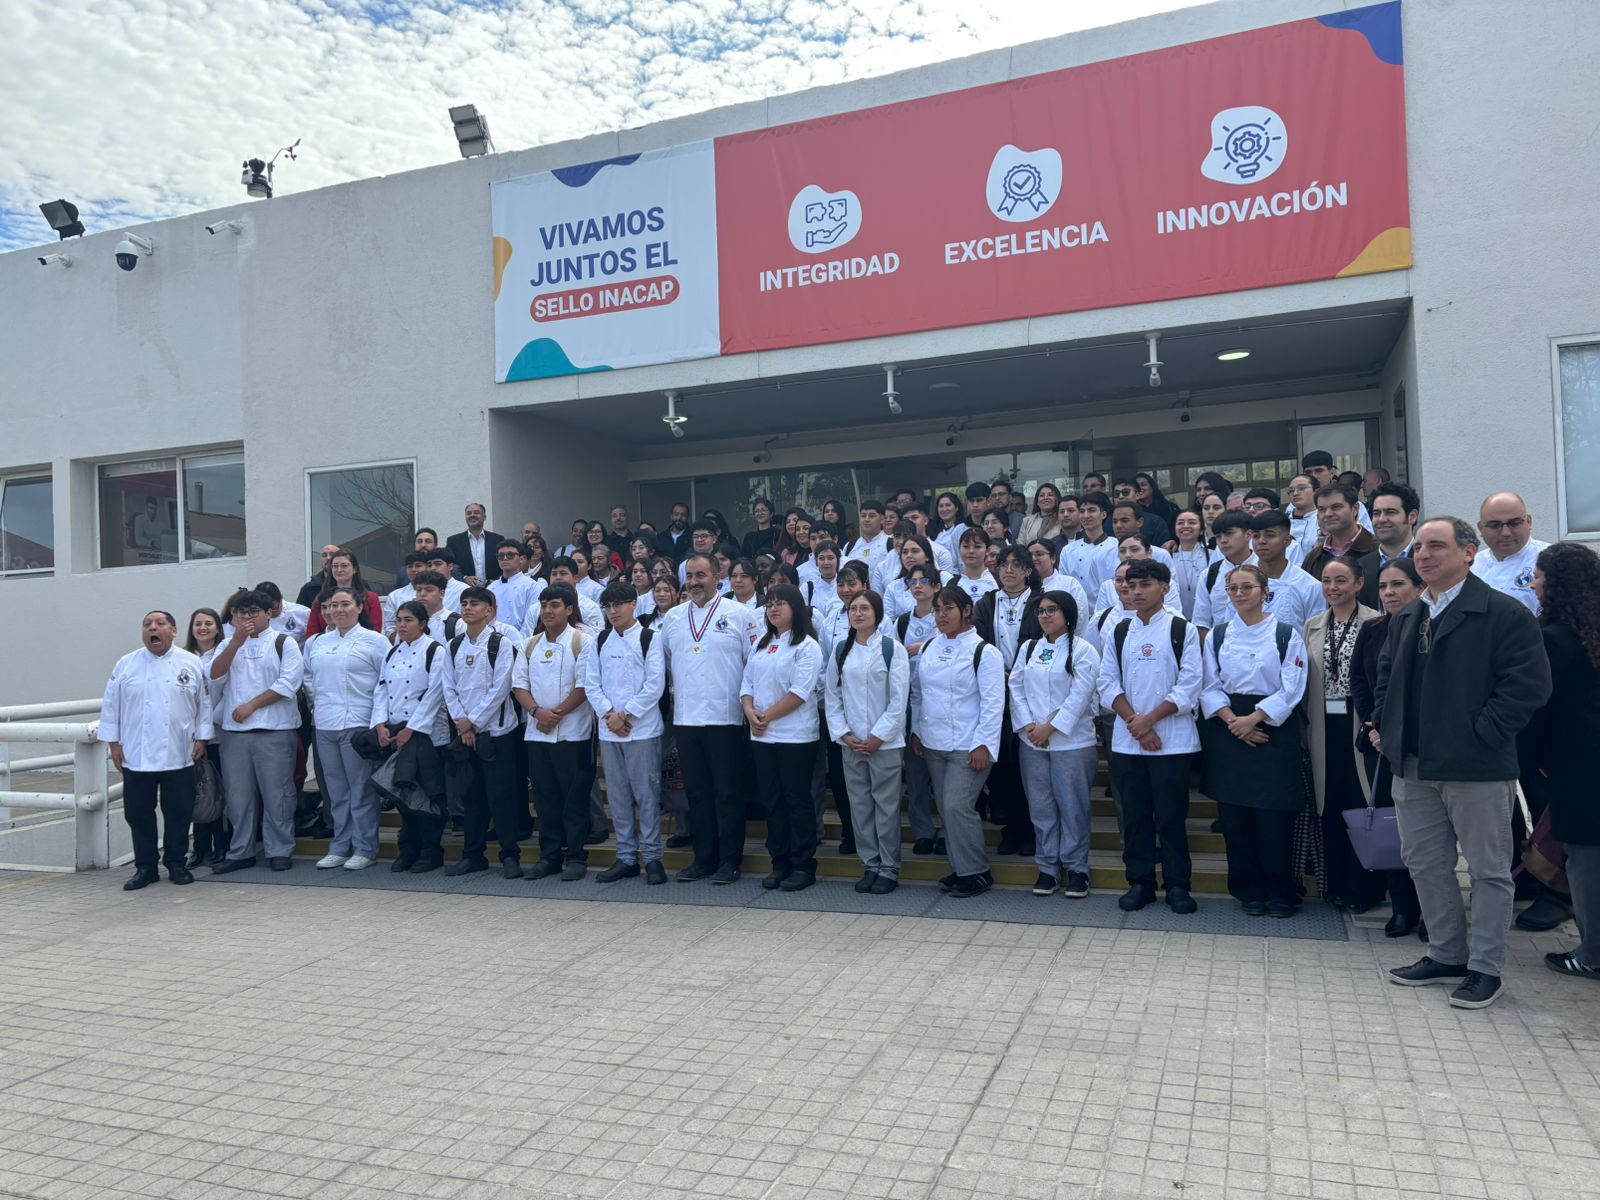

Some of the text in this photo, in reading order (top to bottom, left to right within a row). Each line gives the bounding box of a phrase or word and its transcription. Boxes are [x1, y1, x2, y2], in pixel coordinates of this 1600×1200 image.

[538, 206, 665, 250] VIVAMOS
[1157, 181, 1348, 235] INNOVACIÓN
[529, 240, 679, 287] JUNTOS EL
[944, 220, 1110, 265] EXCELENCIA
[759, 252, 901, 292] INTEGRIDAD
[534, 280, 675, 318] SELLO INACAP
